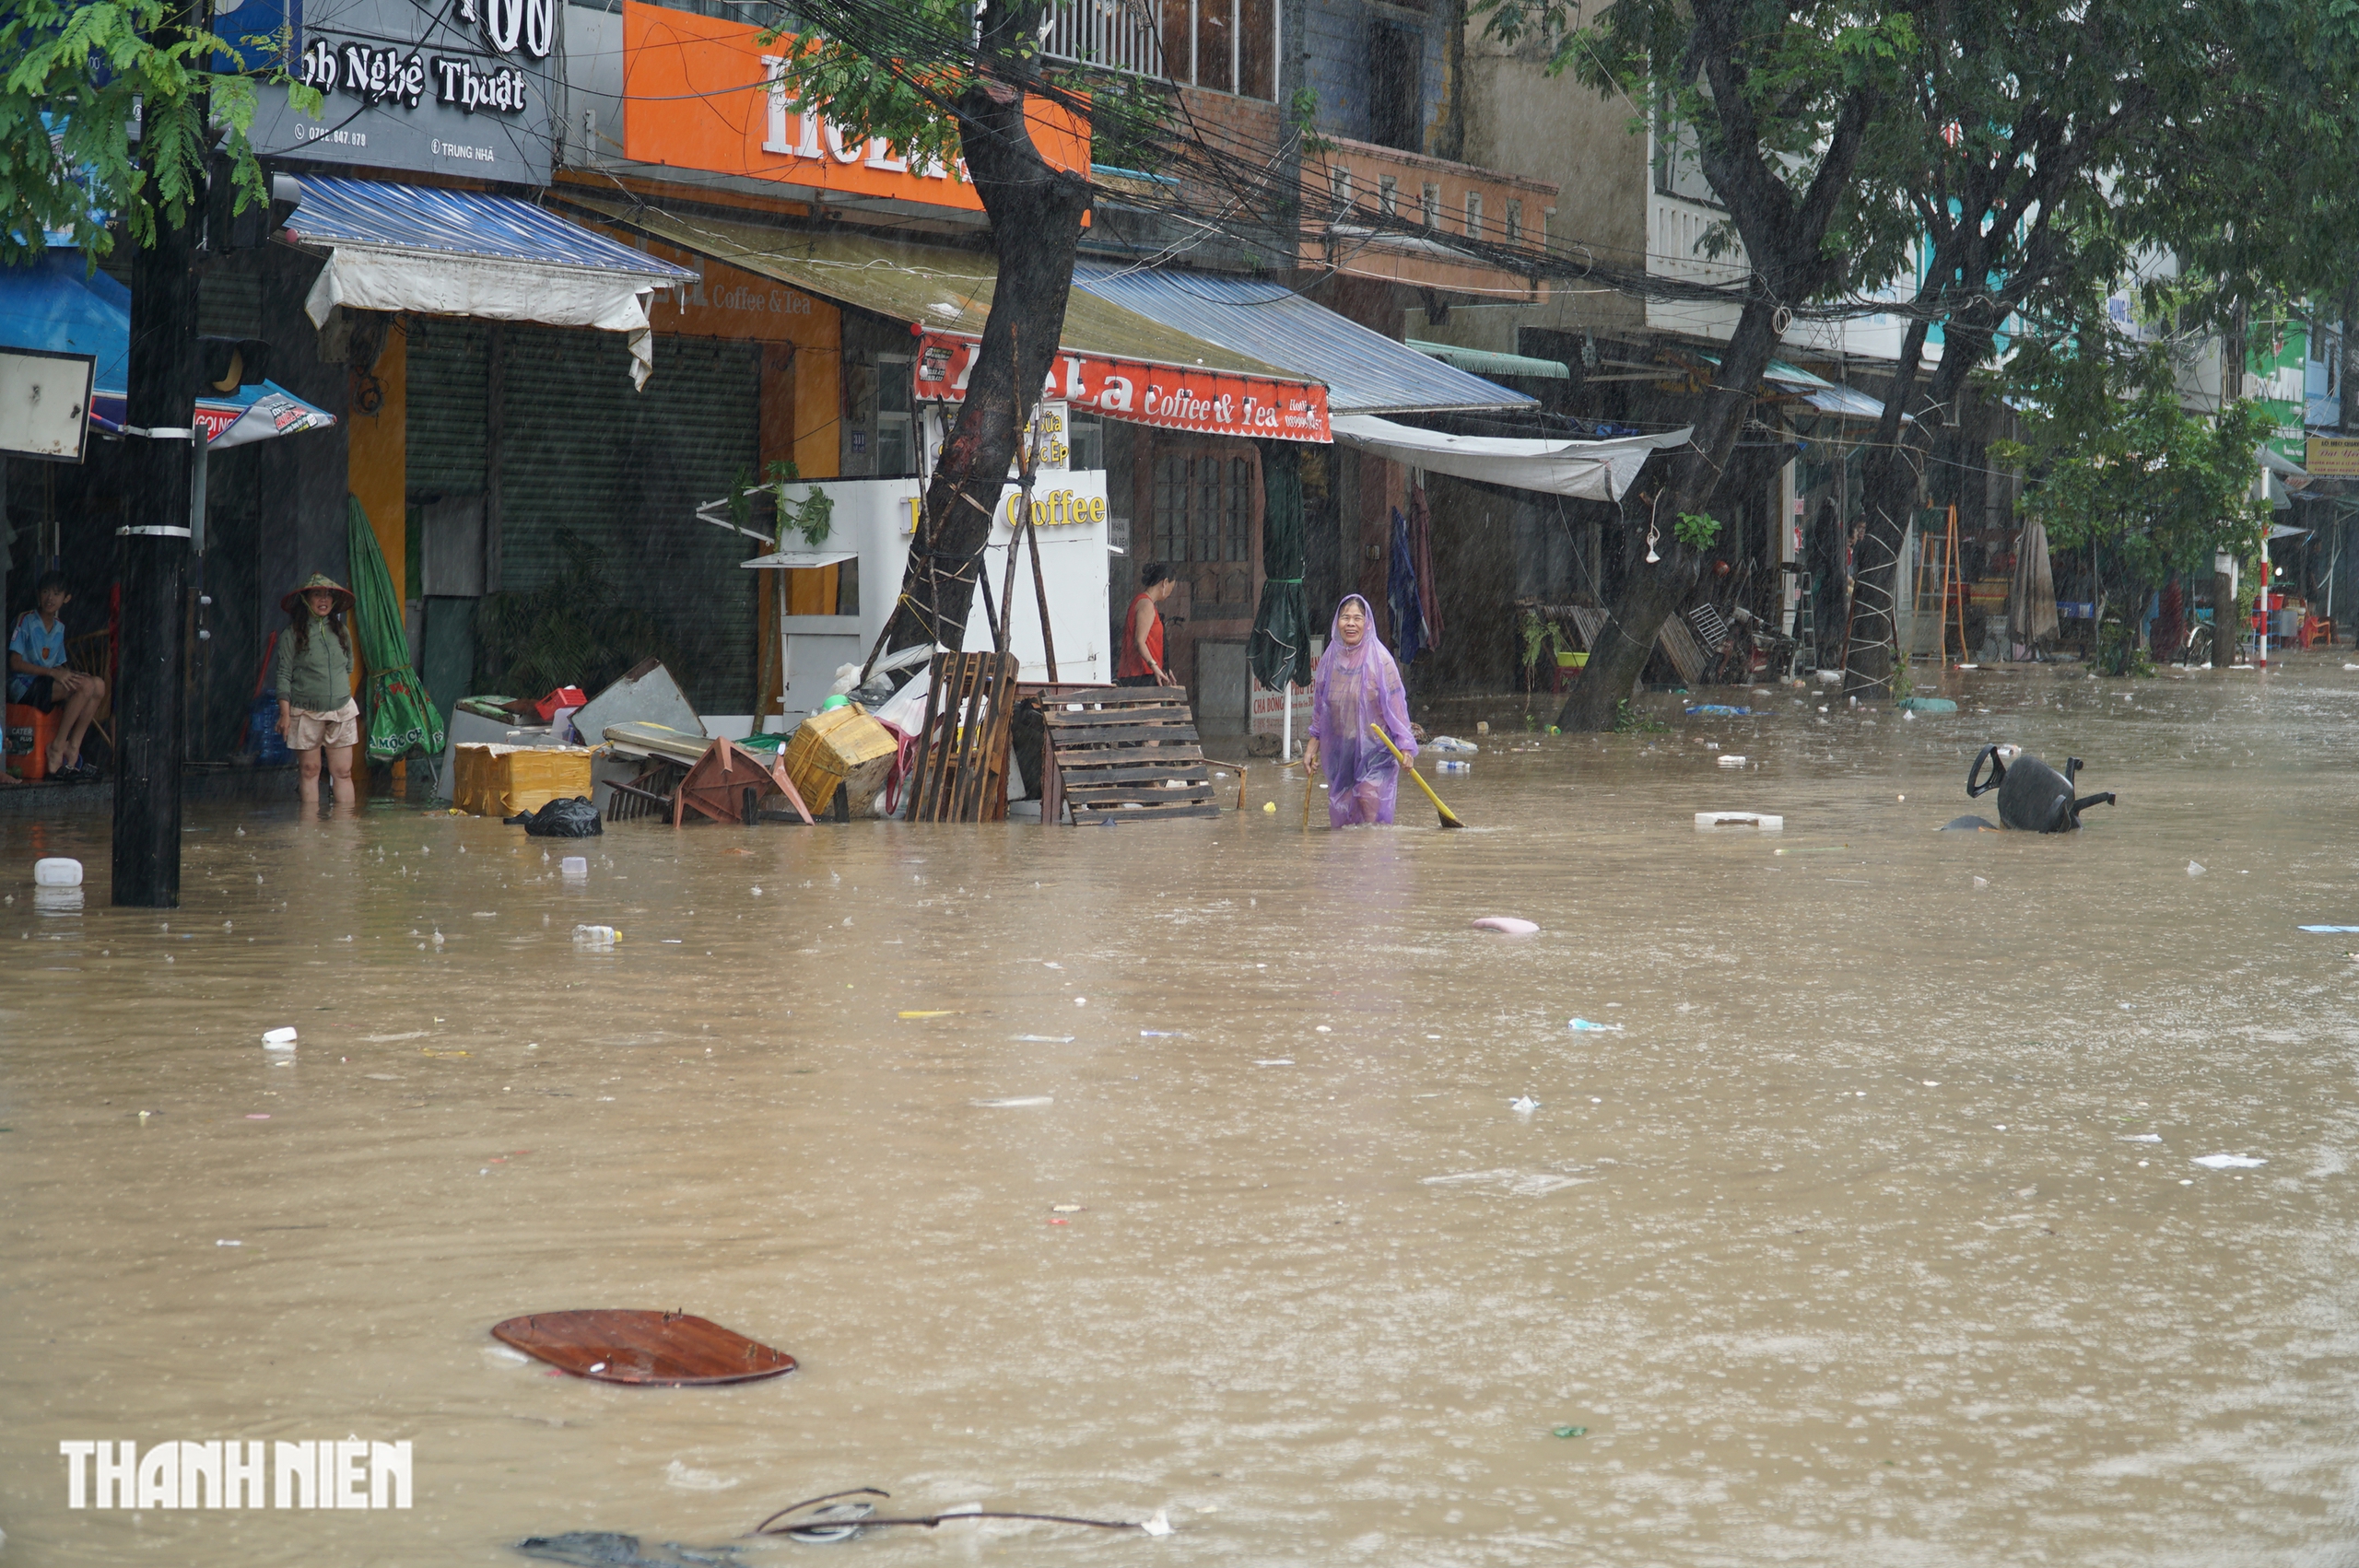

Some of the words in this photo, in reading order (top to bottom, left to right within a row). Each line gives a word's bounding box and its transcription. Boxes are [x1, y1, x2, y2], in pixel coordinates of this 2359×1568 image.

[345, 44, 425, 108] Nghệ
[438, 58, 526, 111] Thuật
[441, 142, 473, 159] TRUNG
[475, 146, 495, 162] NHÃ
[712, 284, 766, 311] Coffee
[769, 289, 782, 313] &
[782, 290, 811, 315] Tea
[1144, 383, 1214, 419] Coffee
[1215, 393, 1235, 425] &
[1242, 396, 1280, 428] Tea
[1289, 398, 1318, 414] Hotlie:
[1040, 411, 1062, 433] ữa
[1285, 415, 1323, 431] 089999457
[1050, 434, 1070, 467] Ép
[1005, 489, 1106, 529] Coffee
[1267, 694, 1285, 712] BÔNG
